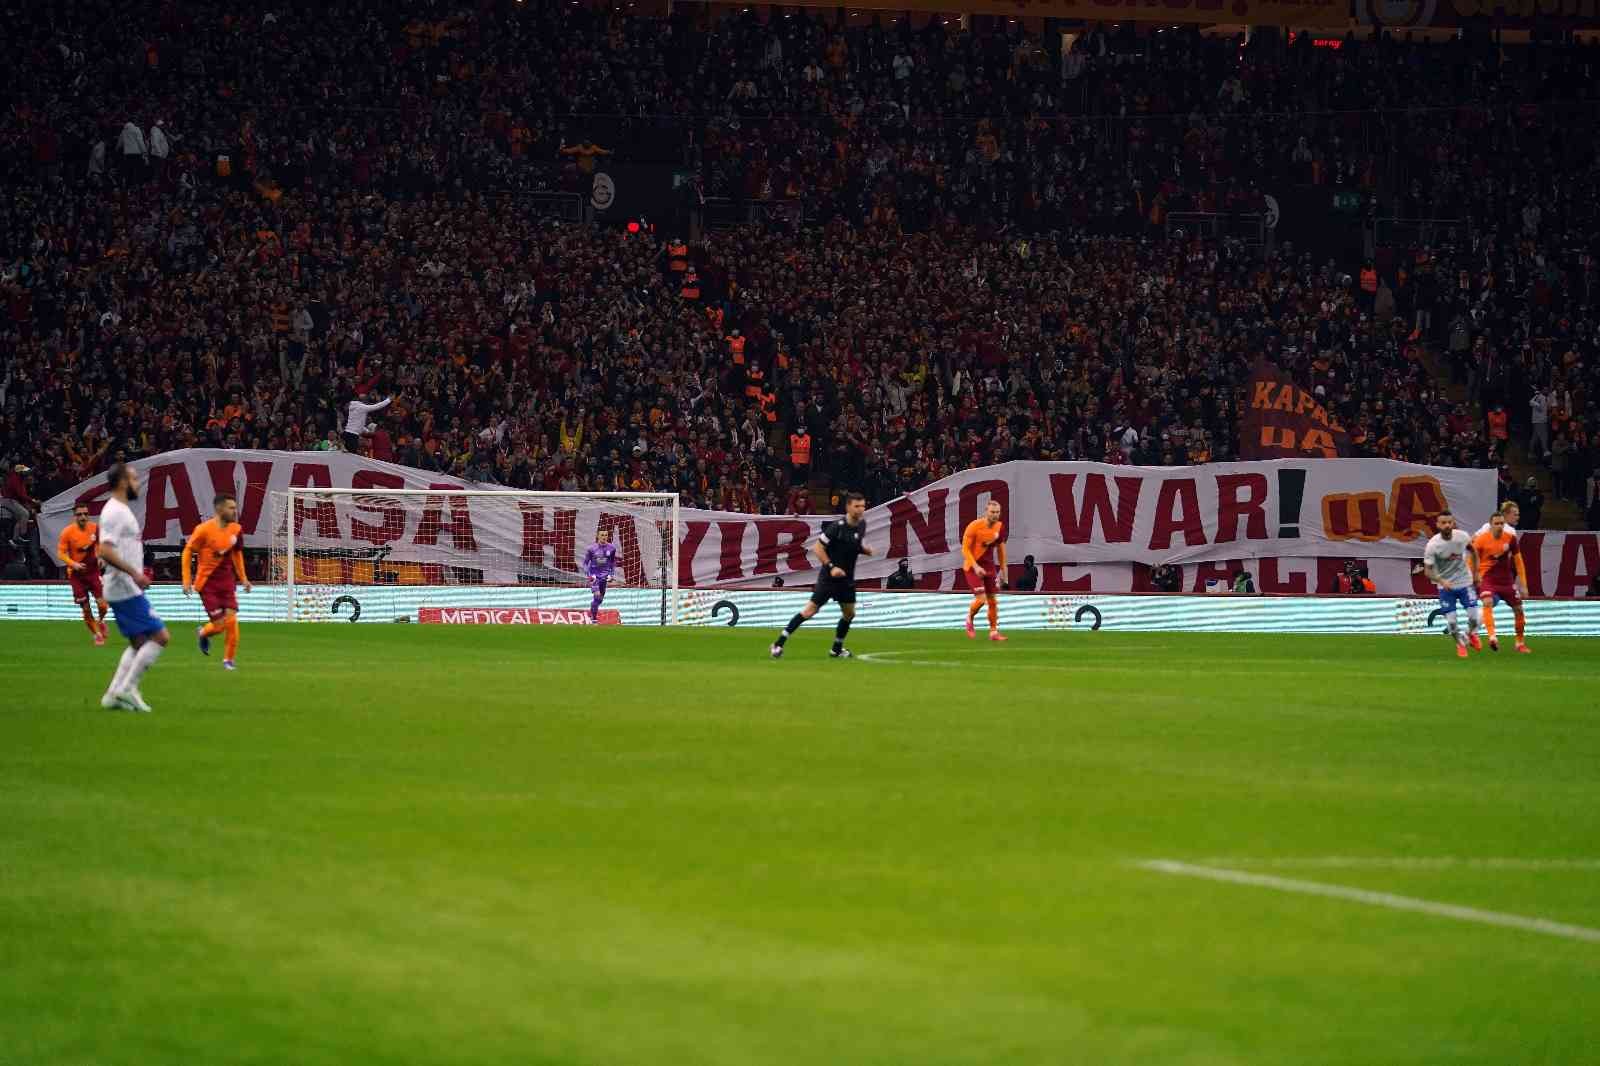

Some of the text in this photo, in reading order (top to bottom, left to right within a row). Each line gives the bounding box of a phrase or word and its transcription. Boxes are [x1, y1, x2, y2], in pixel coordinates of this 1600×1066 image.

[517, 501, 815, 587] HAYIR
[886, 479, 1010, 559] NO
[1048, 468, 1307, 550] WAR!
